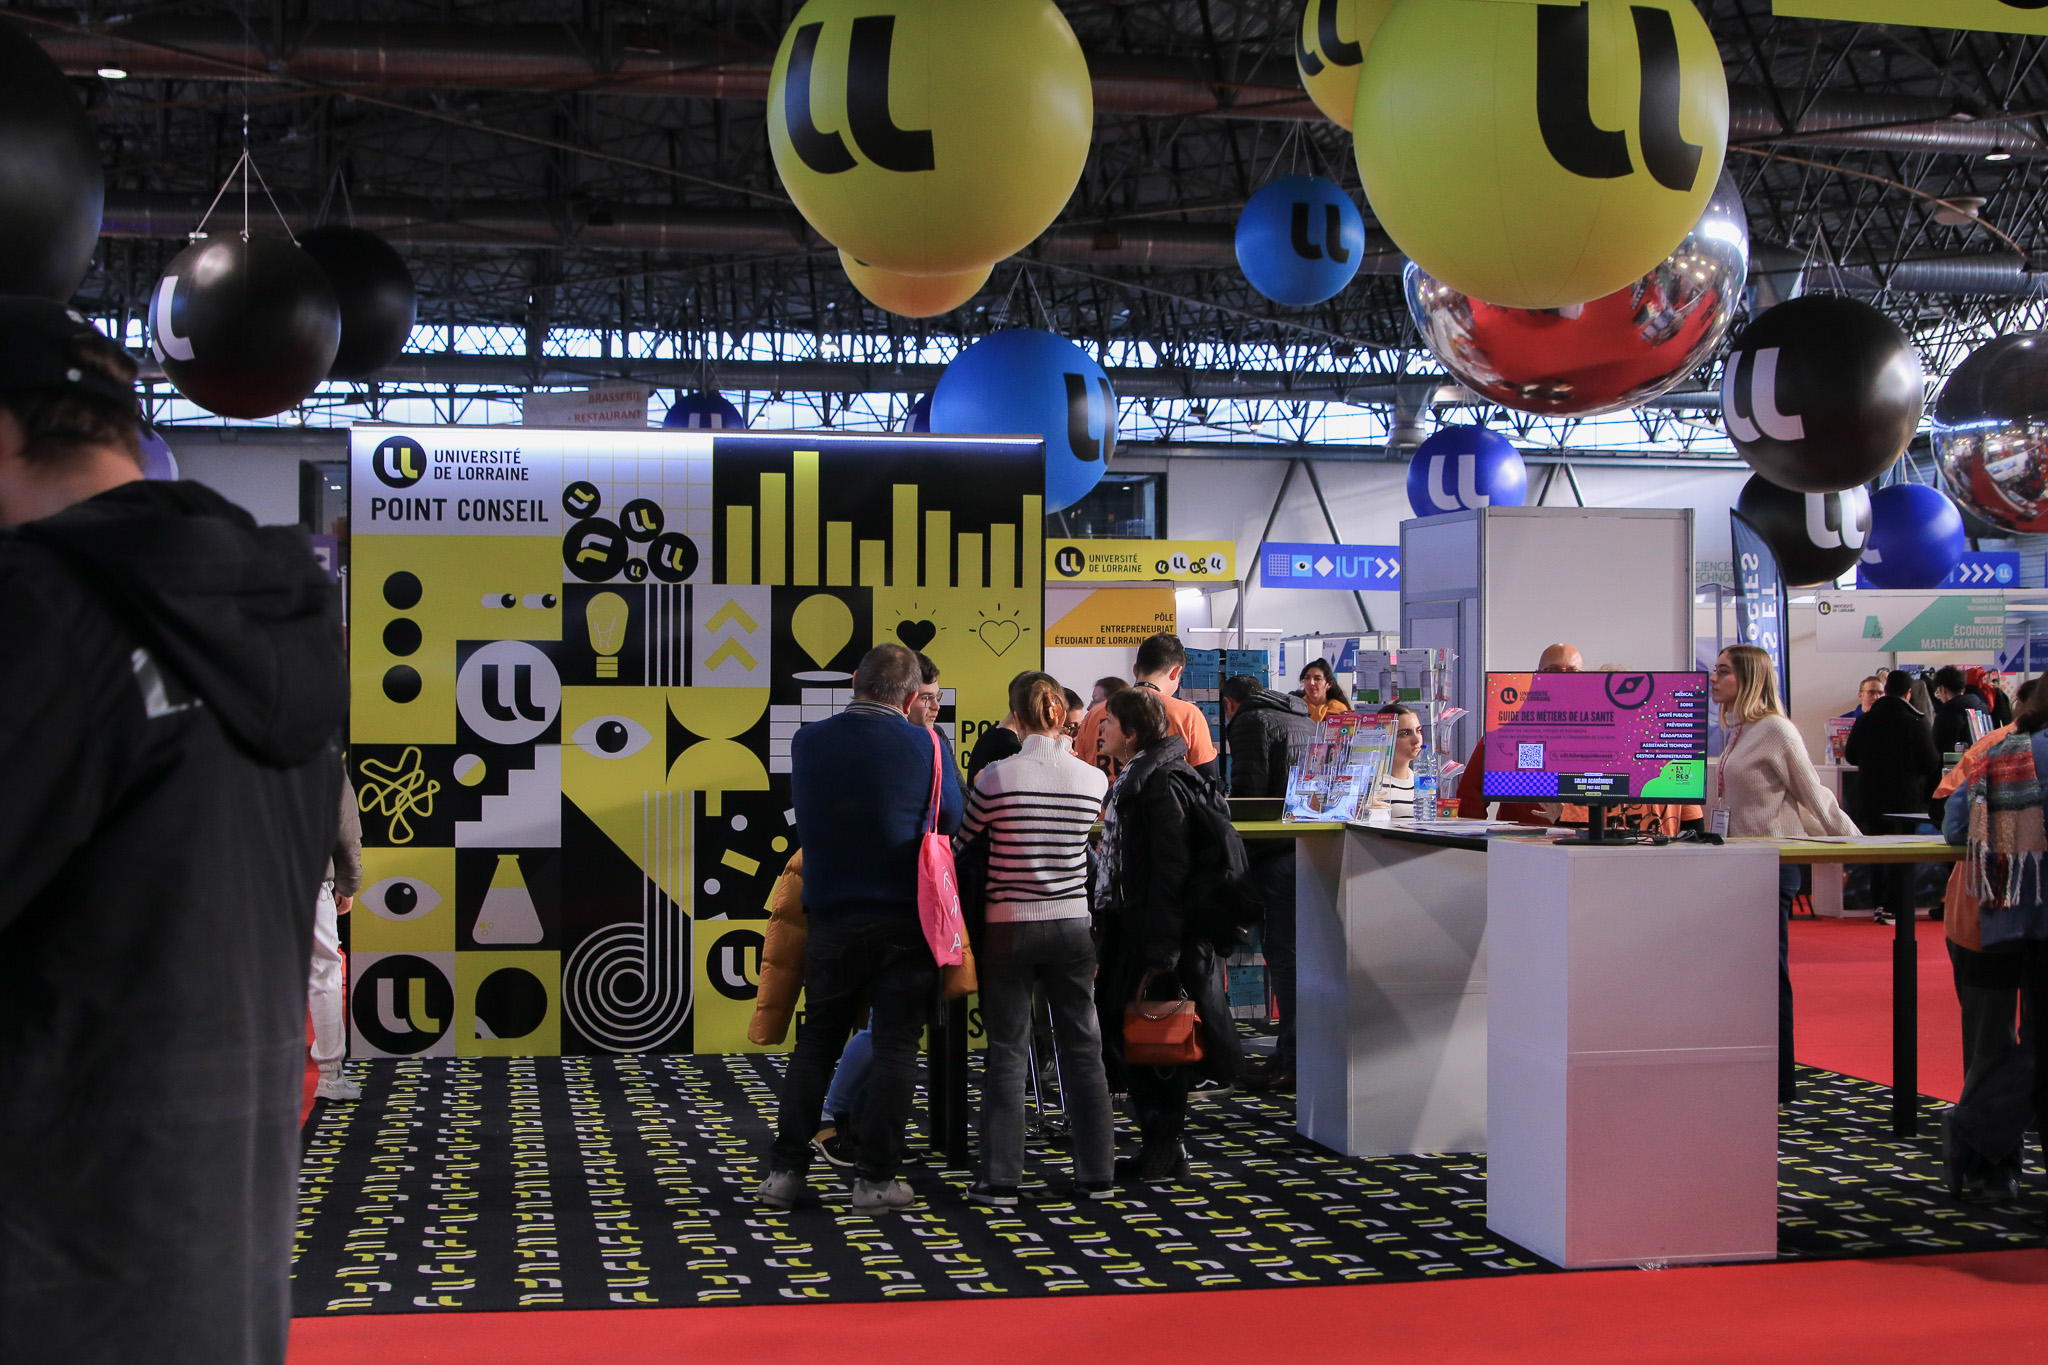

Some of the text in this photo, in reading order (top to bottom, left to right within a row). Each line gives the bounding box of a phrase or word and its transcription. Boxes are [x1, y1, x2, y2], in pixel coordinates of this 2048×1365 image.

[588, 391, 641, 404] BRASSERIE
[574, 410, 641, 423] RESTAURANT
[434, 448, 521, 464] UNIVERSITÉ
[434, 467, 529, 481] DE LORRAINE
[371, 497, 548, 522] POINT CONSEIL
[1089, 553, 1138, 563] UNIVERSITÉ
[1089, 564, 1142, 573] DE LORRAINE
[1336, 556, 1375, 578] IUT
[1696, 561, 1733, 572] CIENCE
[1696, 572, 1734, 582] ECHNO
[1154, 611, 1174, 622] PÔLE
[1100, 625, 1174, 633] ENTREPRENEURIAT
[1953, 623, 2003, 636] ÉCONOMIE
[1055, 634, 1147, 645] ÉTUDIANT DE LORRAINE
[1921, 636, 2004, 650] MATHÉMATIQUES
[1498, 709, 1614, 723] GUIDE DES MÉTIERS DE LA SANTÉ
